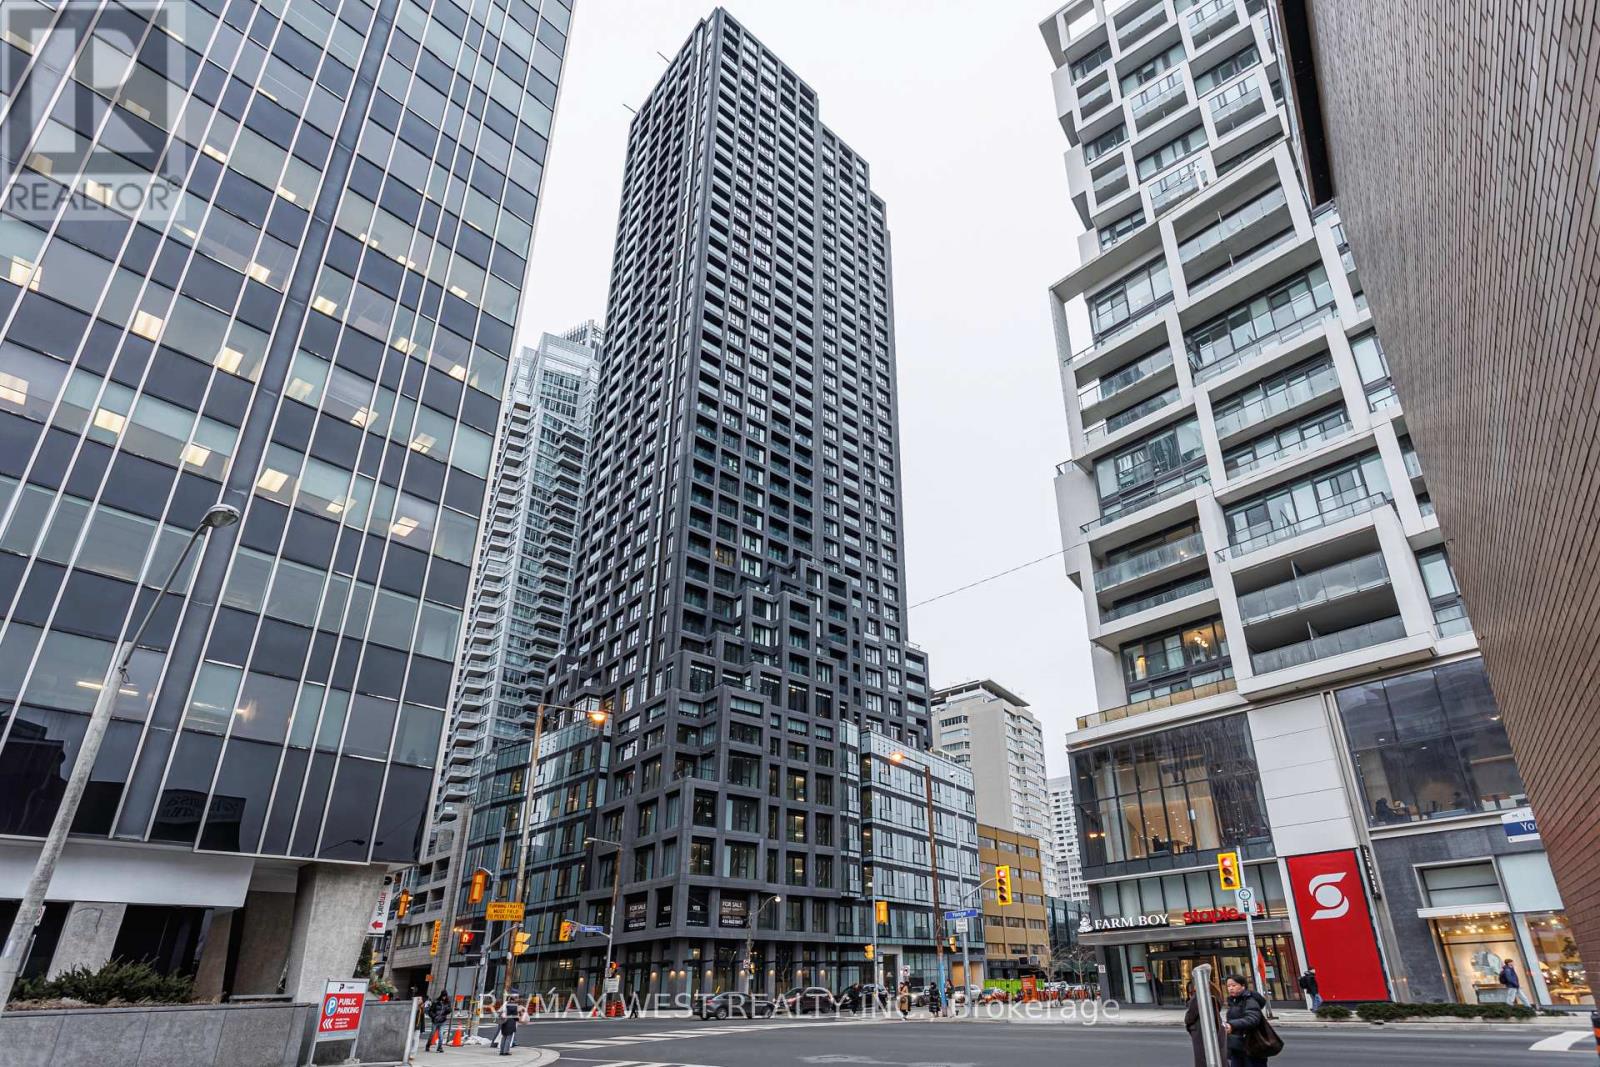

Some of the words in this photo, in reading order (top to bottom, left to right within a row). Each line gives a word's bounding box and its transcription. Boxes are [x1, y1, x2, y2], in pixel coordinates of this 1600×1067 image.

[1094, 916, 1134, 930] FARM
[1138, 913, 1169, 926] BOY
[1183, 906, 1247, 925] staple
